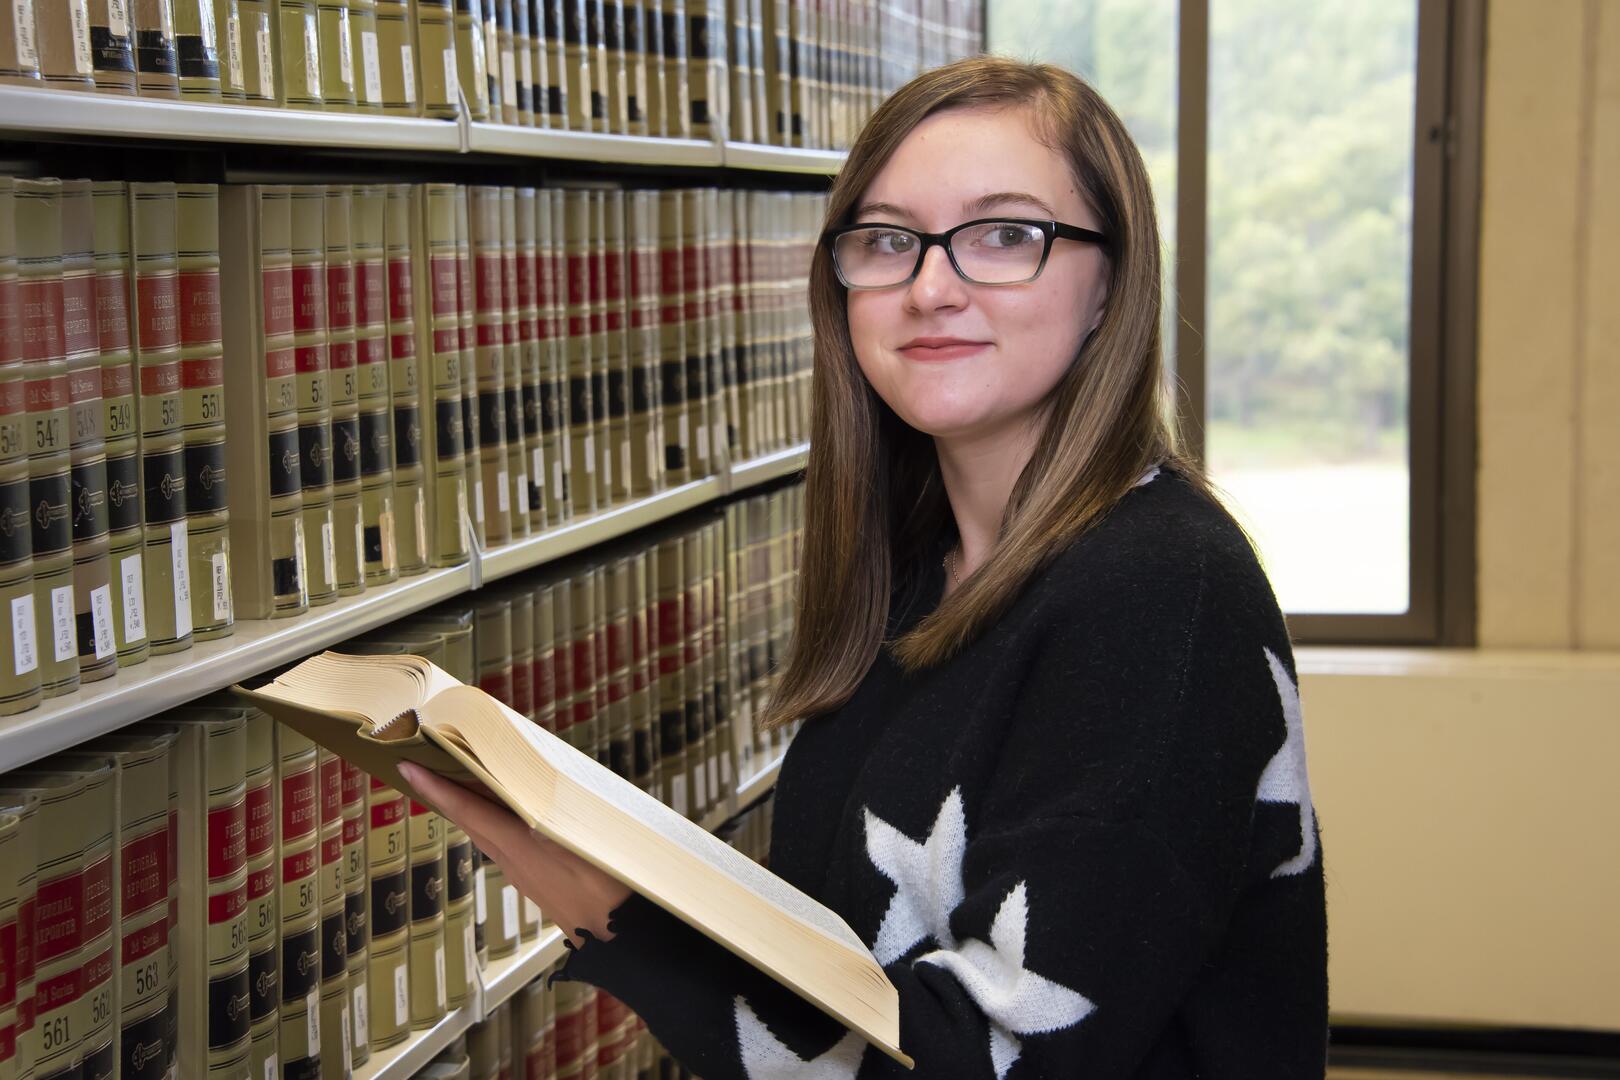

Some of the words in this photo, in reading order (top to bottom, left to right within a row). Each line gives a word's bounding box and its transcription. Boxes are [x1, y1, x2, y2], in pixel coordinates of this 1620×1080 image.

[109, 403, 131, 432] 549
[201, 394, 221, 420] 551
[36, 418, 59, 448] 547
[128, 850, 158, 876] FEDERAL
[136, 960, 159, 995] 563
[92, 989, 111, 1024] 562
[43, 1016, 71, 1050] 561
